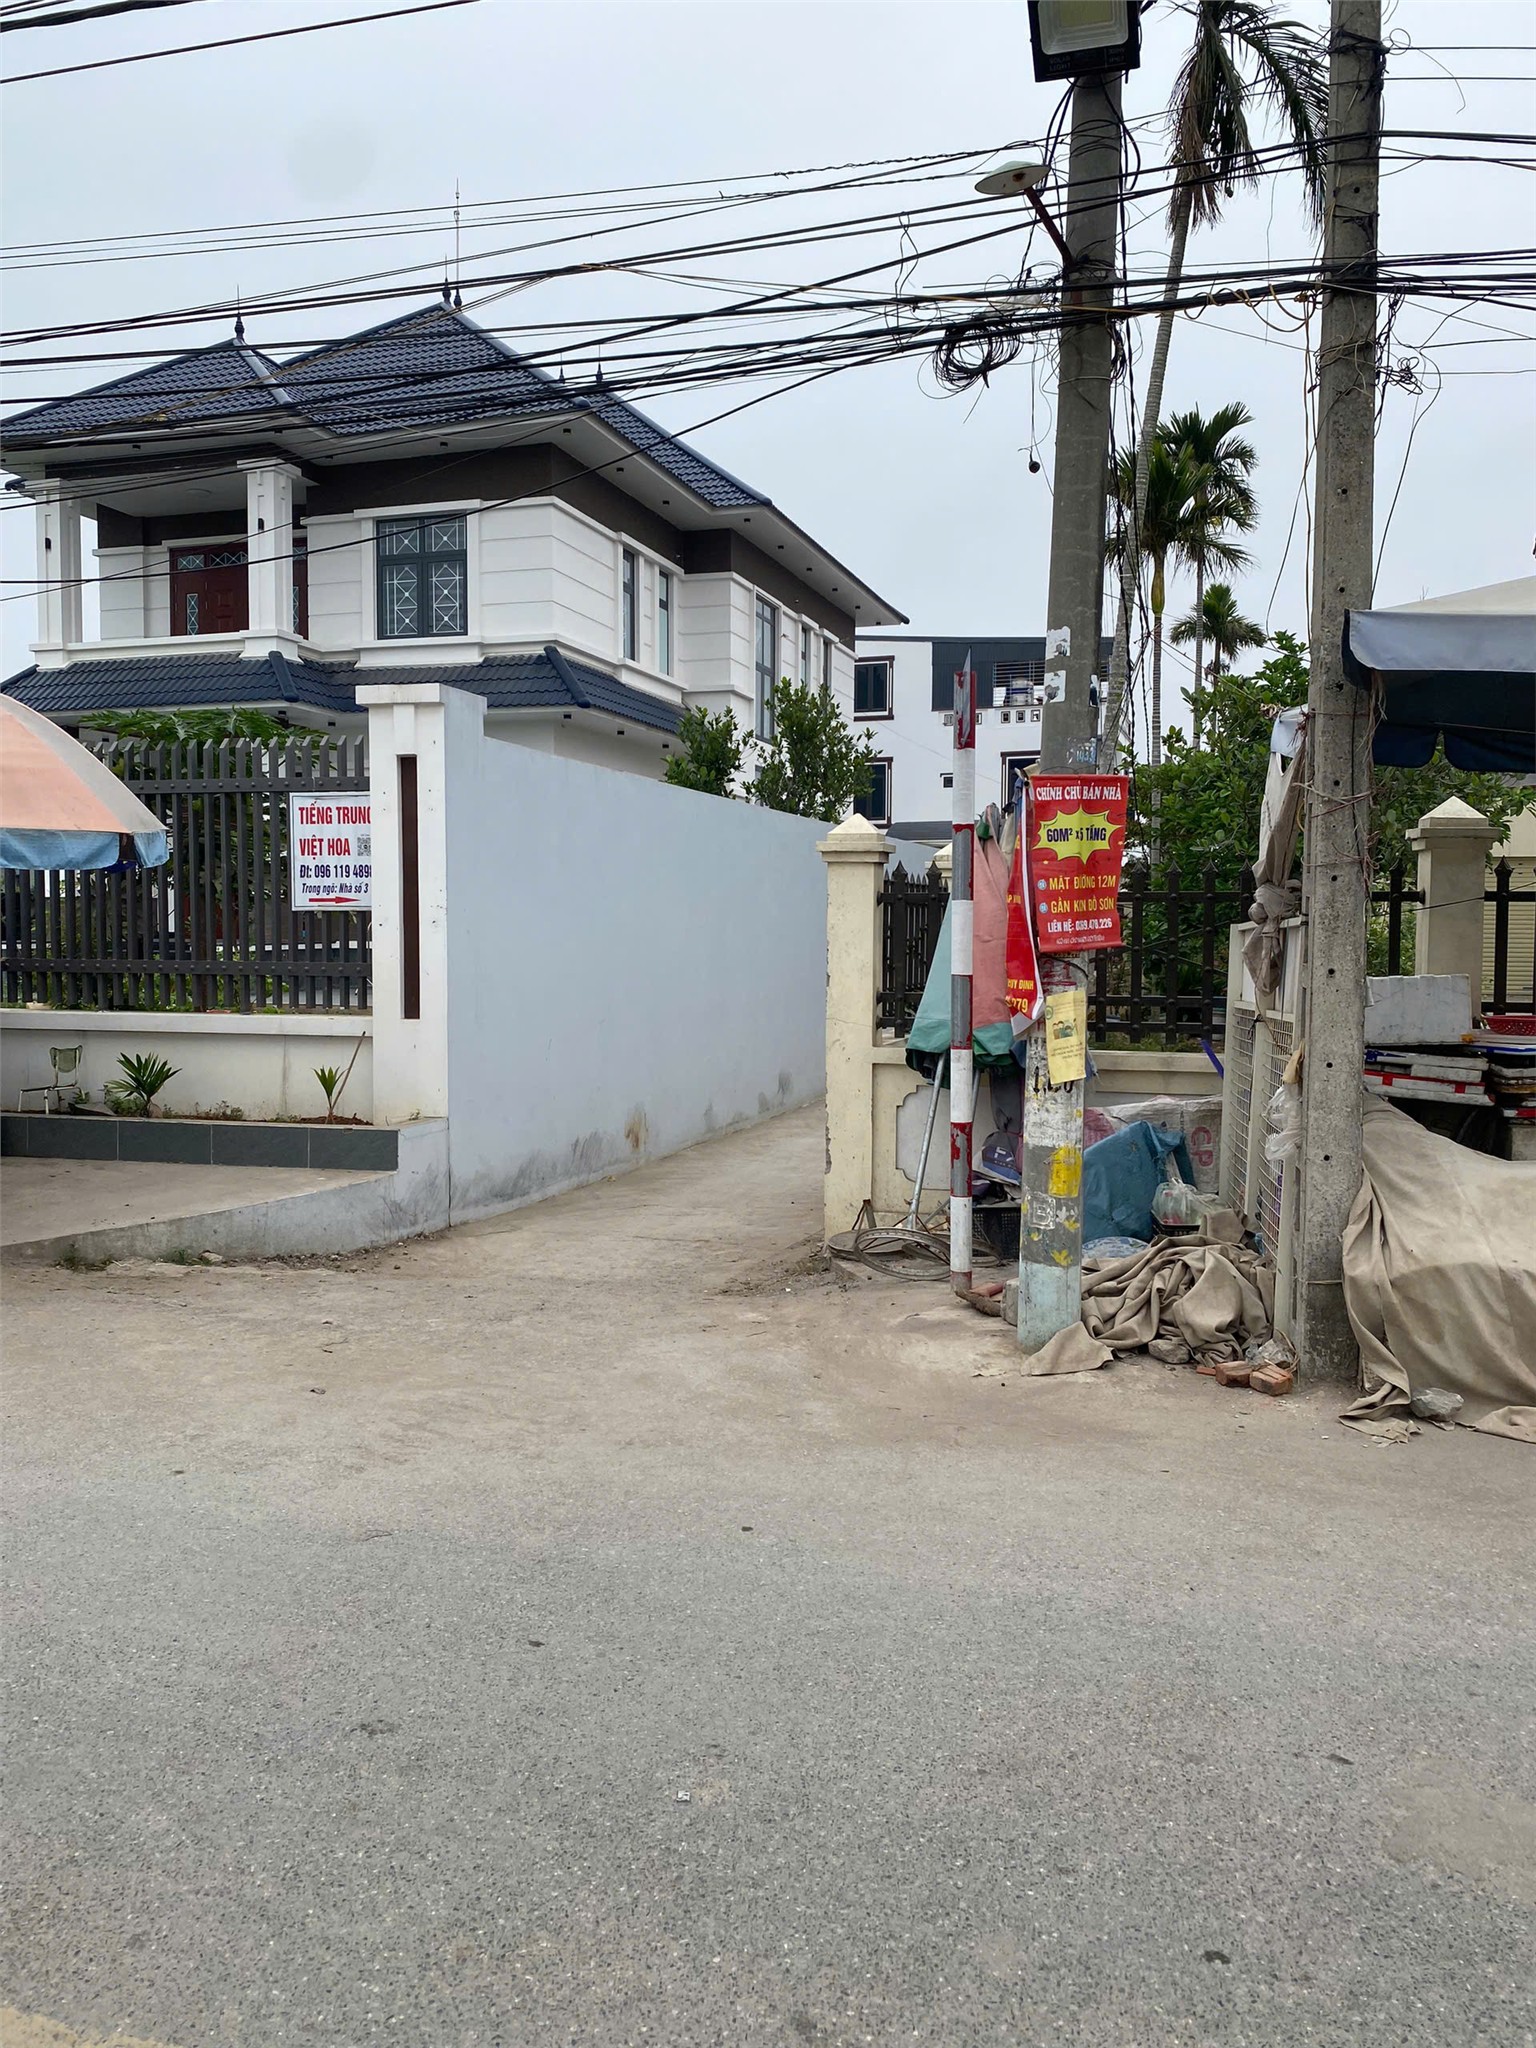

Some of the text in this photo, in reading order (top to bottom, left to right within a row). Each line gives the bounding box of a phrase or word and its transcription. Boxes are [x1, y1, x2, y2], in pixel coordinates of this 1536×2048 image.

[1036, 782, 1062, 801] CHÍNH
[1082, 782, 1101, 800] BÁN
[1102, 782, 1122, 800] NHÀ
[298, 800, 333, 825] TIẾNG
[299, 834, 351, 860] VIỆT HOA
[314, 864, 331, 878] 096
[333, 864, 350, 878] 119
[353, 864, 371, 878] 489
[301, 881, 369, 896] Trong ngõ: Nhà số 3
[1098, 875, 1116, 888] 12M
[1050, 896, 1070, 914] GẦN
[1099, 895, 1114, 910] SƠN
[1047, 919, 1062, 933] LIÊN
[1018, 979, 1034, 992] ĐỊNH
